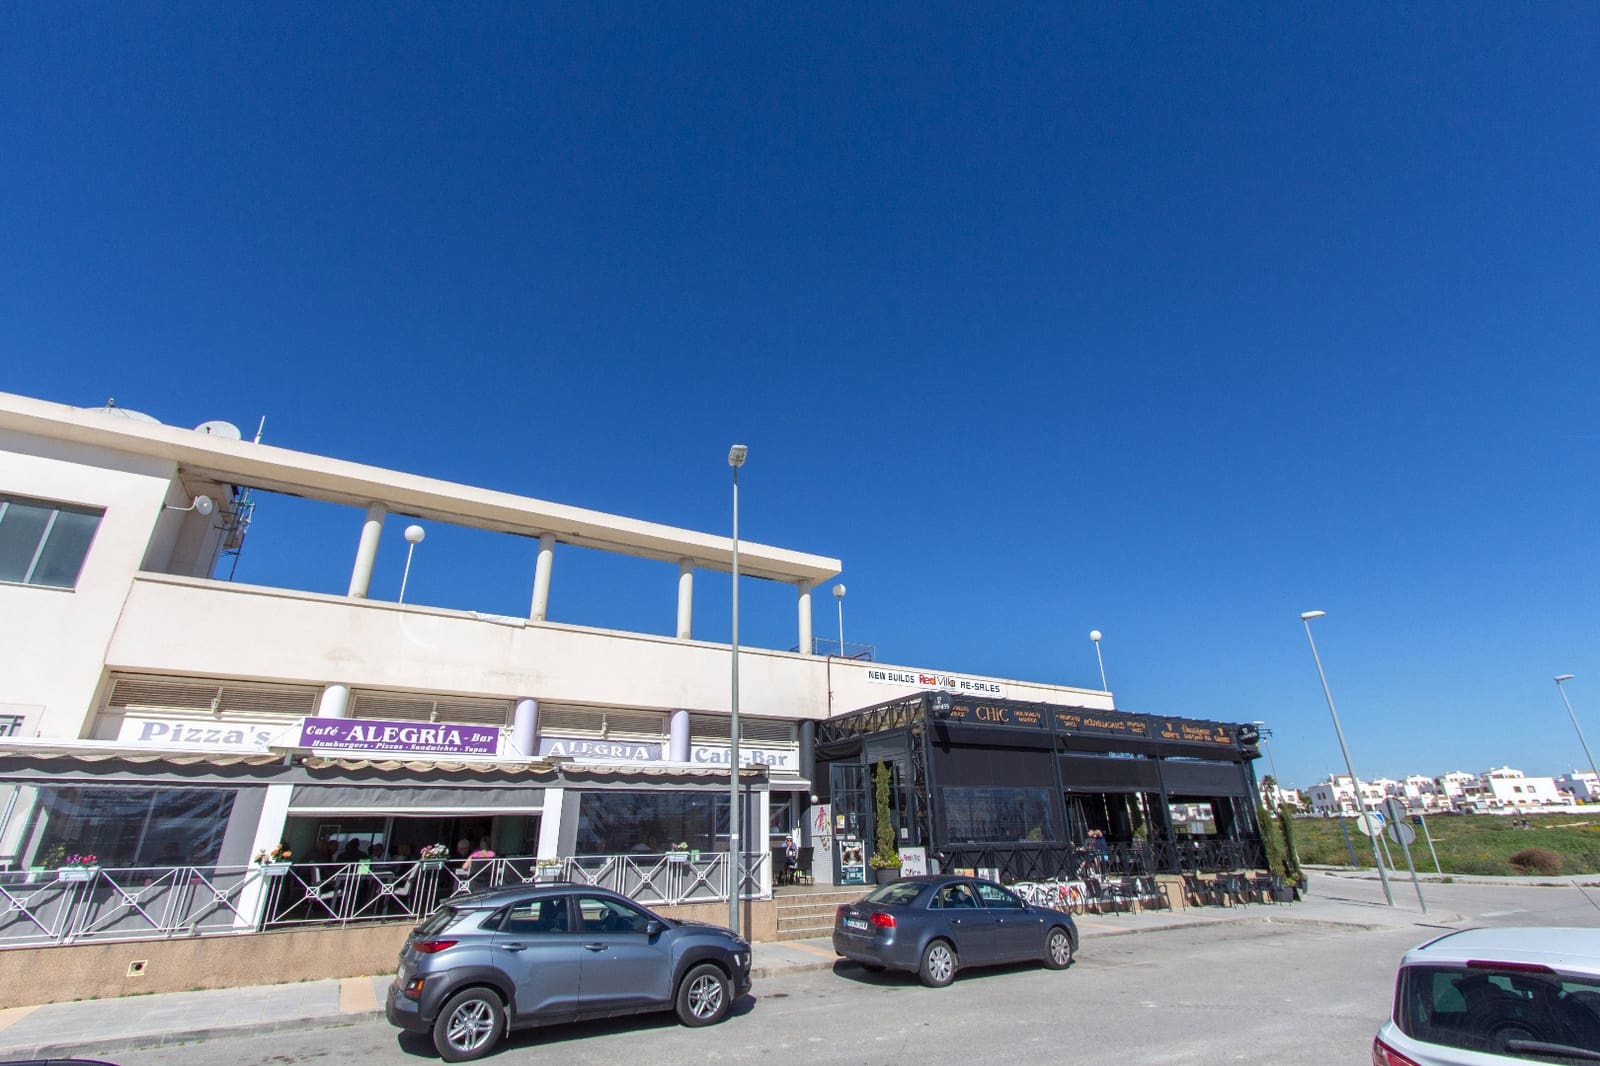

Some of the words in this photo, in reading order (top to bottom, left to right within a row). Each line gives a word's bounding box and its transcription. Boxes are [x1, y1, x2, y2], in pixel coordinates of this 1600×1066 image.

[868, 670, 886, 680] NEW
[888, 673, 915, 683] BUILDS
[960, 681, 1001, 693] RE-SALES
[975, 706, 1010, 723] CHIC
[138, 721, 272, 746] Pizza's
[305, 725, 340, 736] Café
[344, 725, 462, 745] ALEGRÍA
[471, 733, 494, 744] Bar
[312, 740, 368, 749] Hamburgers
[375, 742, 404, 750] Pizzas
[410, 744, 458, 752] Sandwiches
[464, 745, 488, 754] Tapas
[695, 747, 788, 767] Caf-Bar
